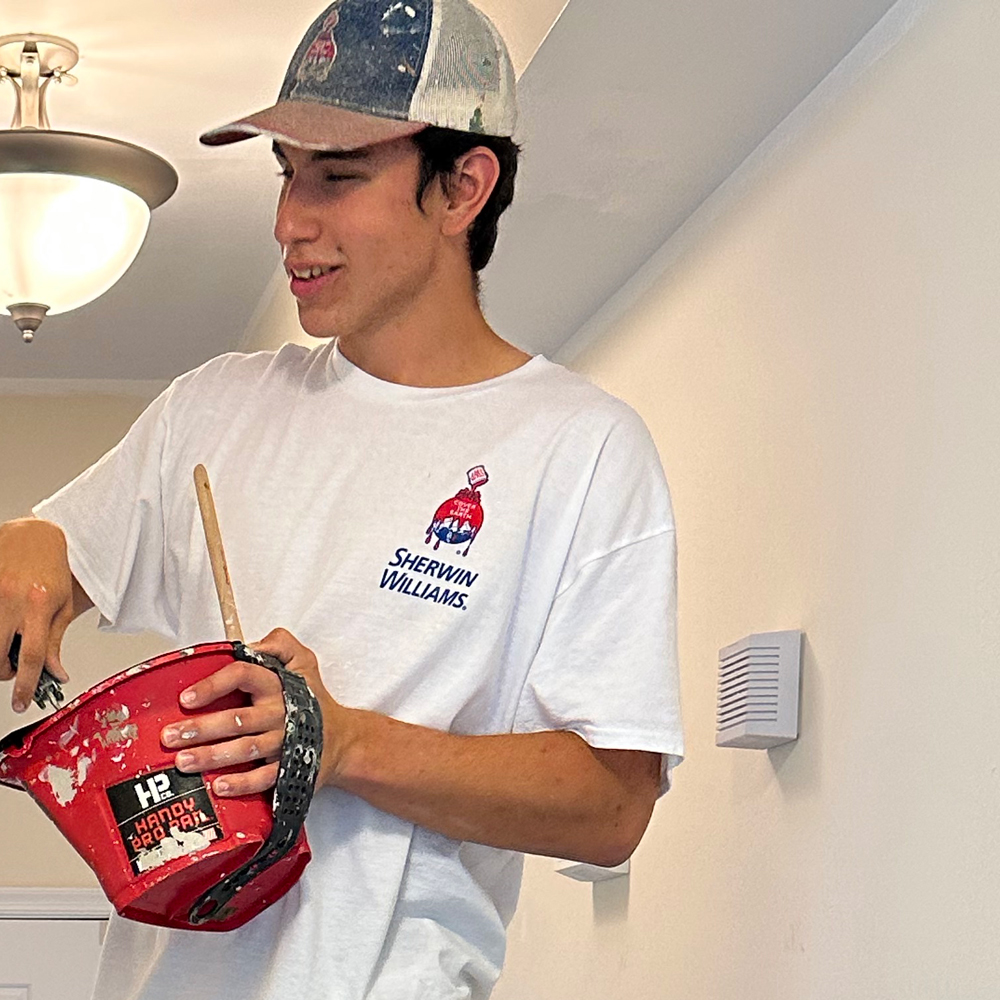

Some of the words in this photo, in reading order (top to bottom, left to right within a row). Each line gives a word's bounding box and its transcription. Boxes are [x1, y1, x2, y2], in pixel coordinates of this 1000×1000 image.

[388, 548, 479, 587] SHERWIN
[134, 773, 171, 809] HP
[134, 797, 196, 834] HANDY
[131, 825, 166, 853] PRO
